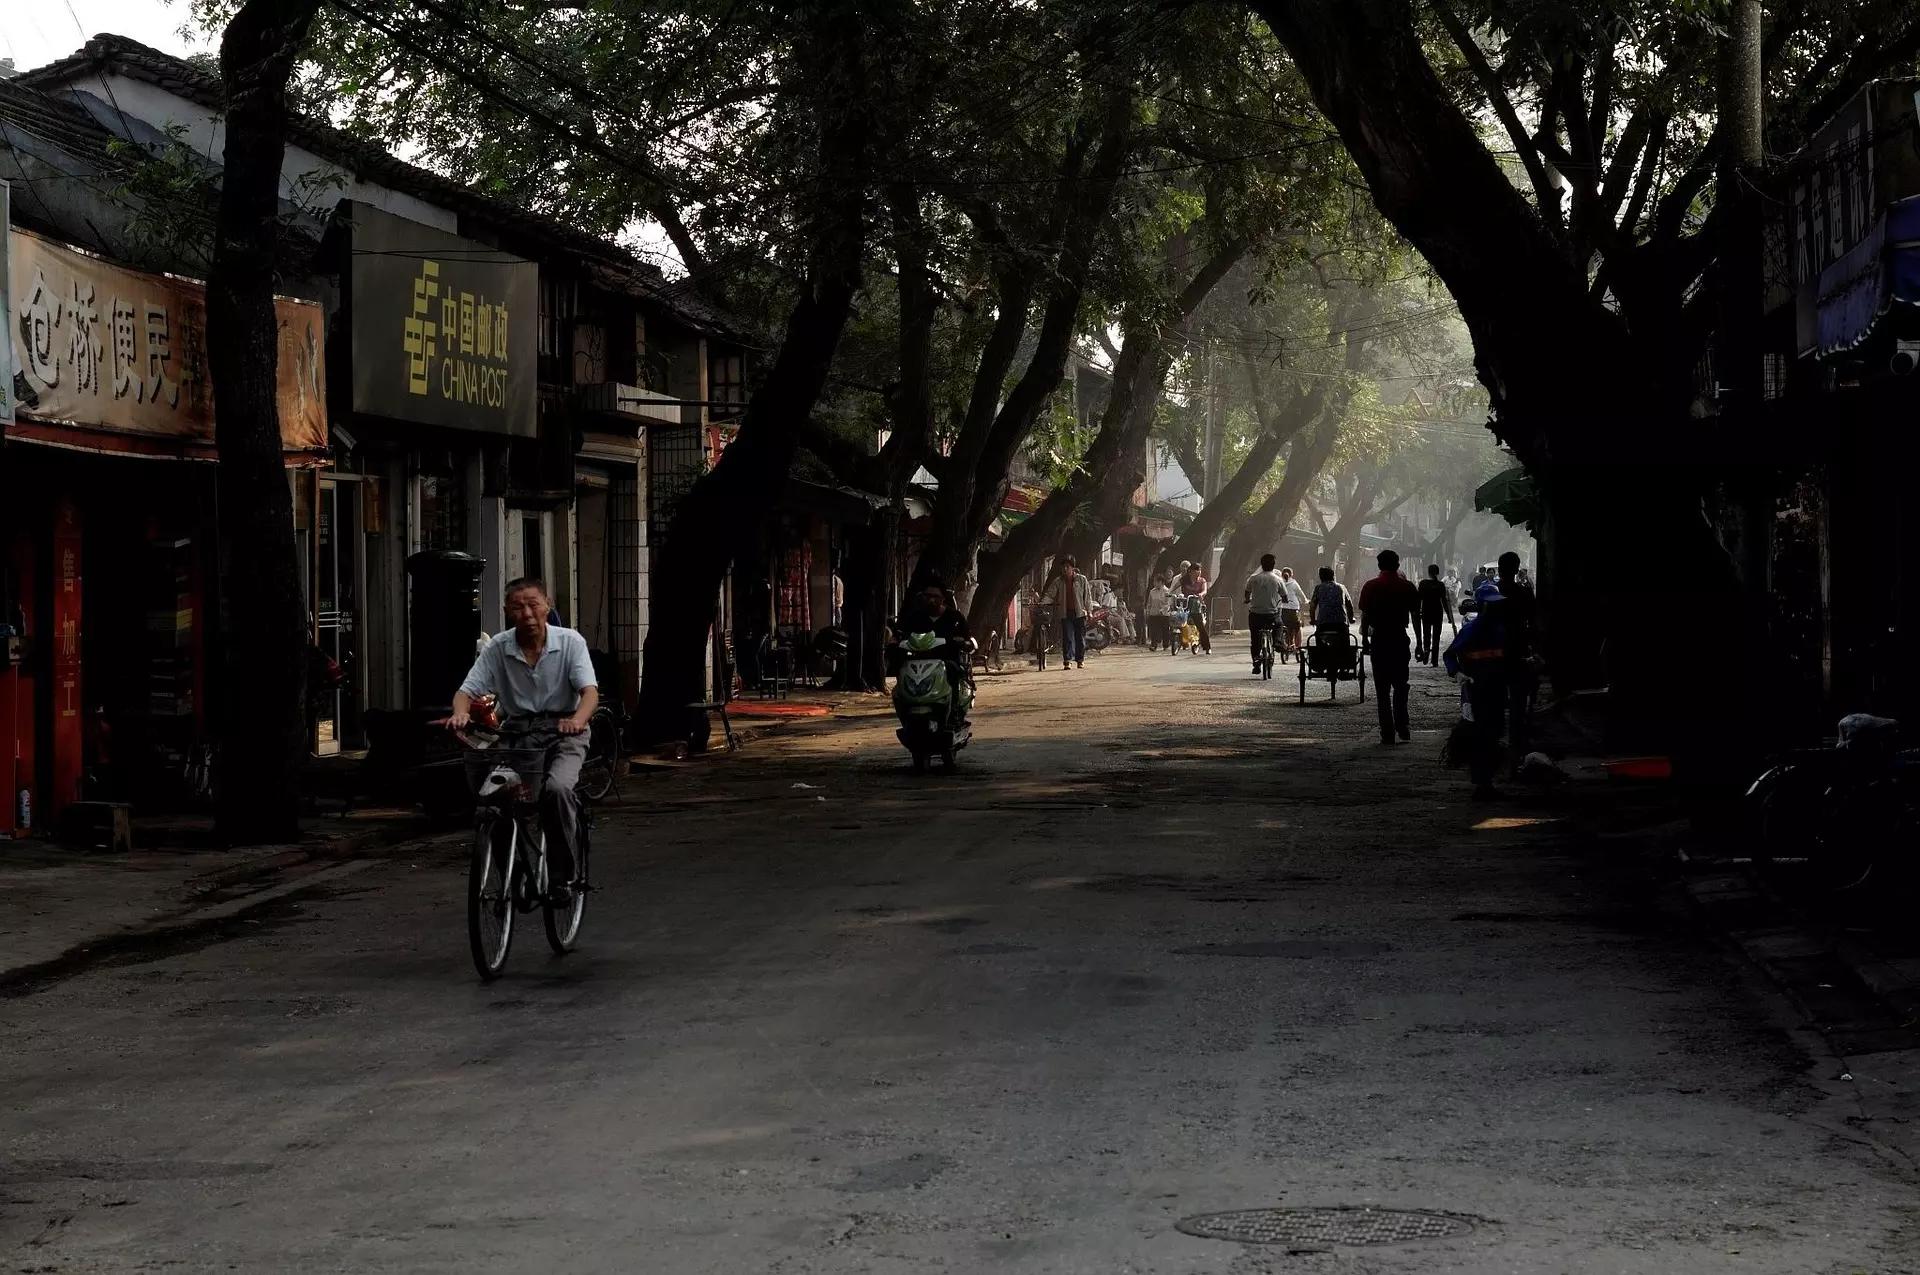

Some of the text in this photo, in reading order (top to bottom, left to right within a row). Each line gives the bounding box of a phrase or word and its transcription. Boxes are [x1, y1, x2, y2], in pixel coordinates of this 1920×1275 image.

[442, 285, 508, 362] 中国邮政
[442, 358, 508, 408] CHINA POST
